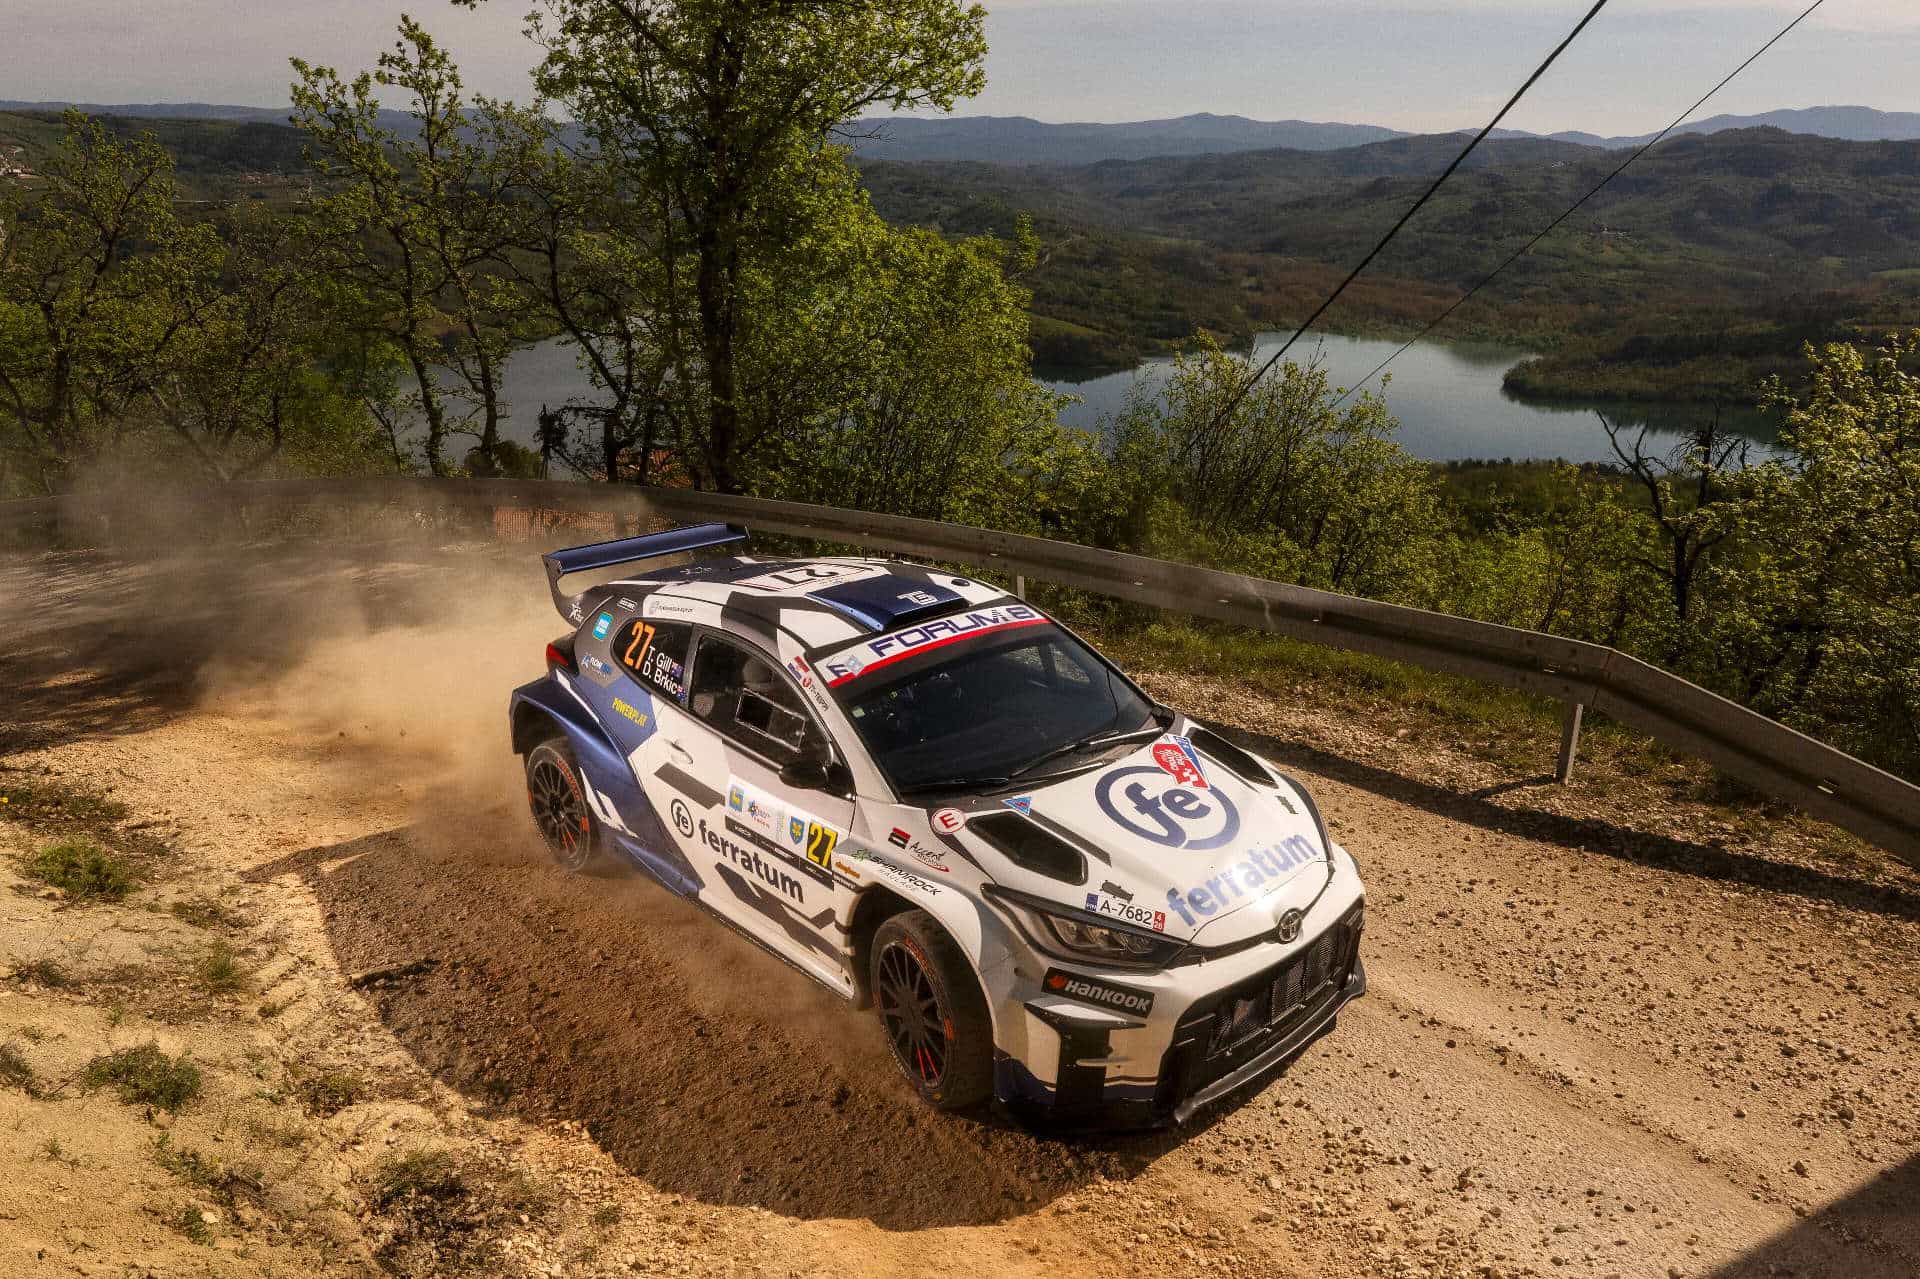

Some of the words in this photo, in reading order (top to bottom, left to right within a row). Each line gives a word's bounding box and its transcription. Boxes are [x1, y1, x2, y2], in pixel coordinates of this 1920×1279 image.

[624, 621, 656, 670] 27
[648, 645, 656, 662] T.
[656, 652, 672, 673] Gill
[643, 660, 652, 679] D.
[653, 669, 678, 695] Brkic
[940, 813, 958, 829] E
[699, 819, 804, 904] ferratum
[807, 822, 837, 868] 27
[909, 841, 946, 861] Accent
[871, 856, 942, 896] SHAMROCK
[1166, 833, 1318, 926] ferratum
[1100, 900, 1153, 925] A-7682
